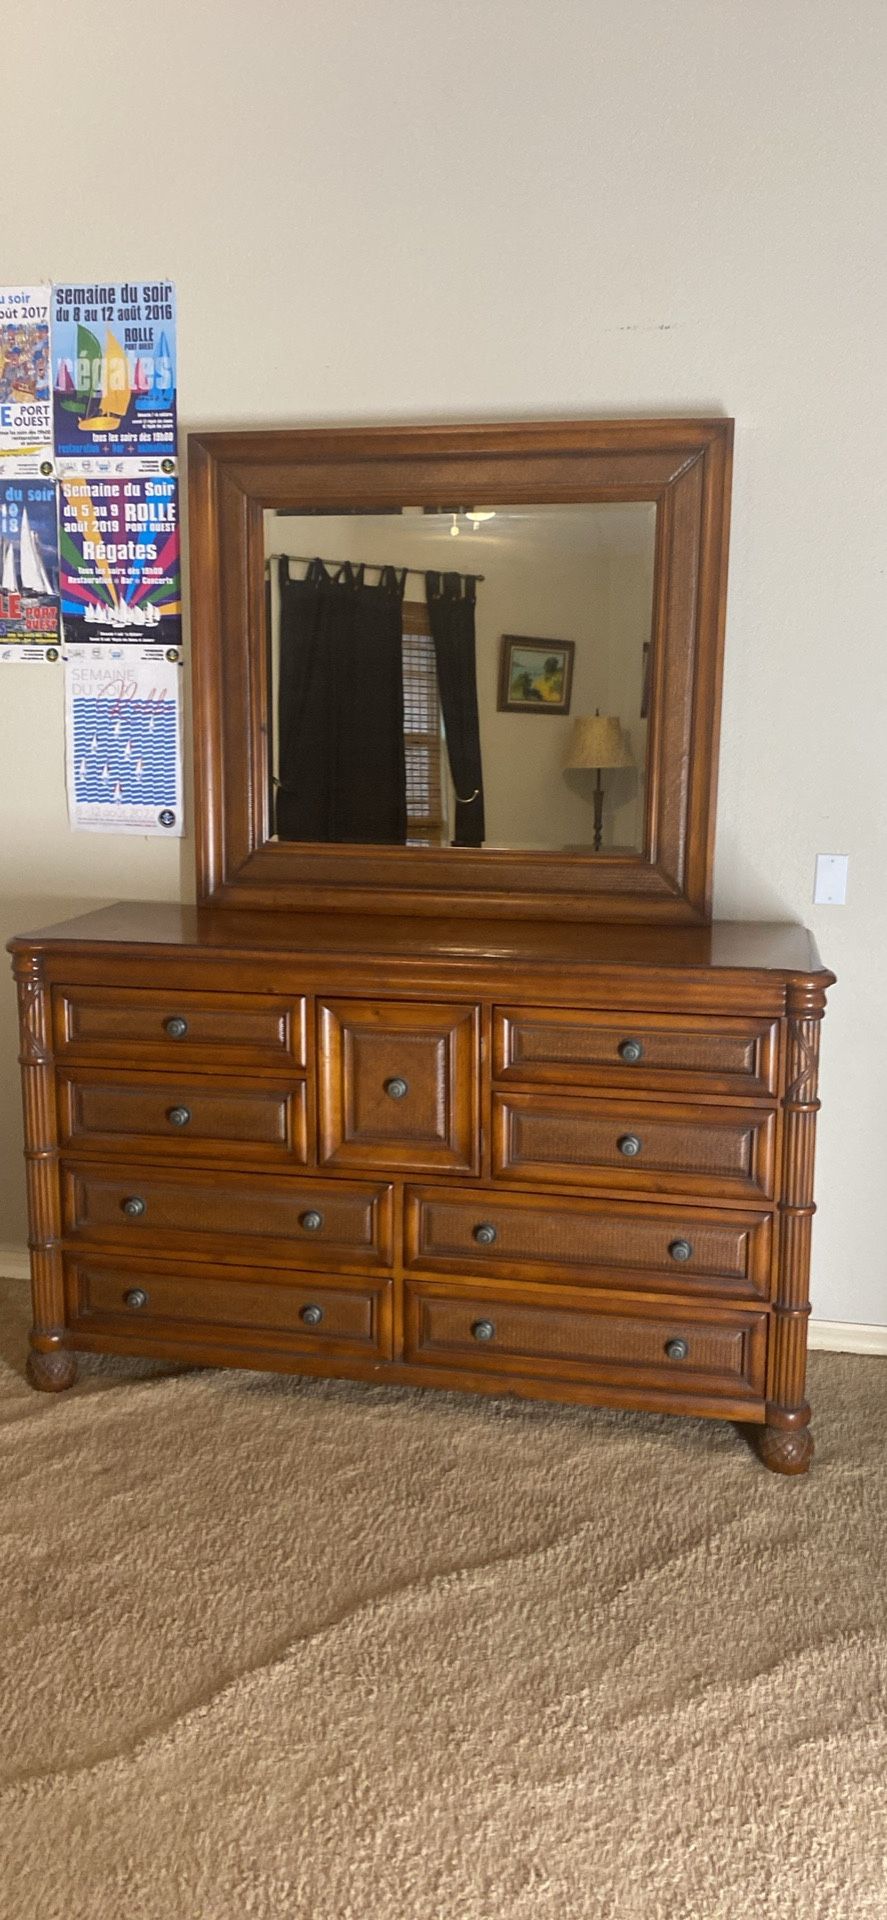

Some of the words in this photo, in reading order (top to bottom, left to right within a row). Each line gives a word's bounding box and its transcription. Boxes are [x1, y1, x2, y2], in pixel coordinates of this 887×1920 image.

[8, 291, 30, 304] soir
[56, 285, 116, 304] semaine
[121, 283, 138, 303] du
[143, 282, 172, 302] soir
[21, 307, 47, 318] 2017
[56, 307, 69, 321] du
[73, 307, 81, 321] 8
[84, 309, 97, 321] au
[101, 306, 114, 321] 12
[118, 305, 141, 321] août
[145, 304, 172, 320] 2016
[124, 327, 153, 342] ROLLE
[20, 405, 49, 415] PORT
[14, 416, 50, 426] OUEST
[5, 487, 23, 501] du
[27, 487, 54, 501] soir
[63, 483, 120, 497] Semaine
[124, 483, 140, 496] du
[145, 482, 175, 496] Soir
[63, 505, 77, 516] du
[81, 505, 89, 516] 5
[93, 506, 108, 516] au
[110, 504, 119, 516] 9
[124, 503, 176, 521] ROLLE
[92, 520, 119, 532] 2019
[125, 523, 146, 532] PORT
[149, 523, 176, 532] OUEST
[83, 541, 157, 563] Régates
[26, 607, 57, 619] PORT
[72, 669, 136, 681] SEMAINE
[72, 684, 91, 695] DU
